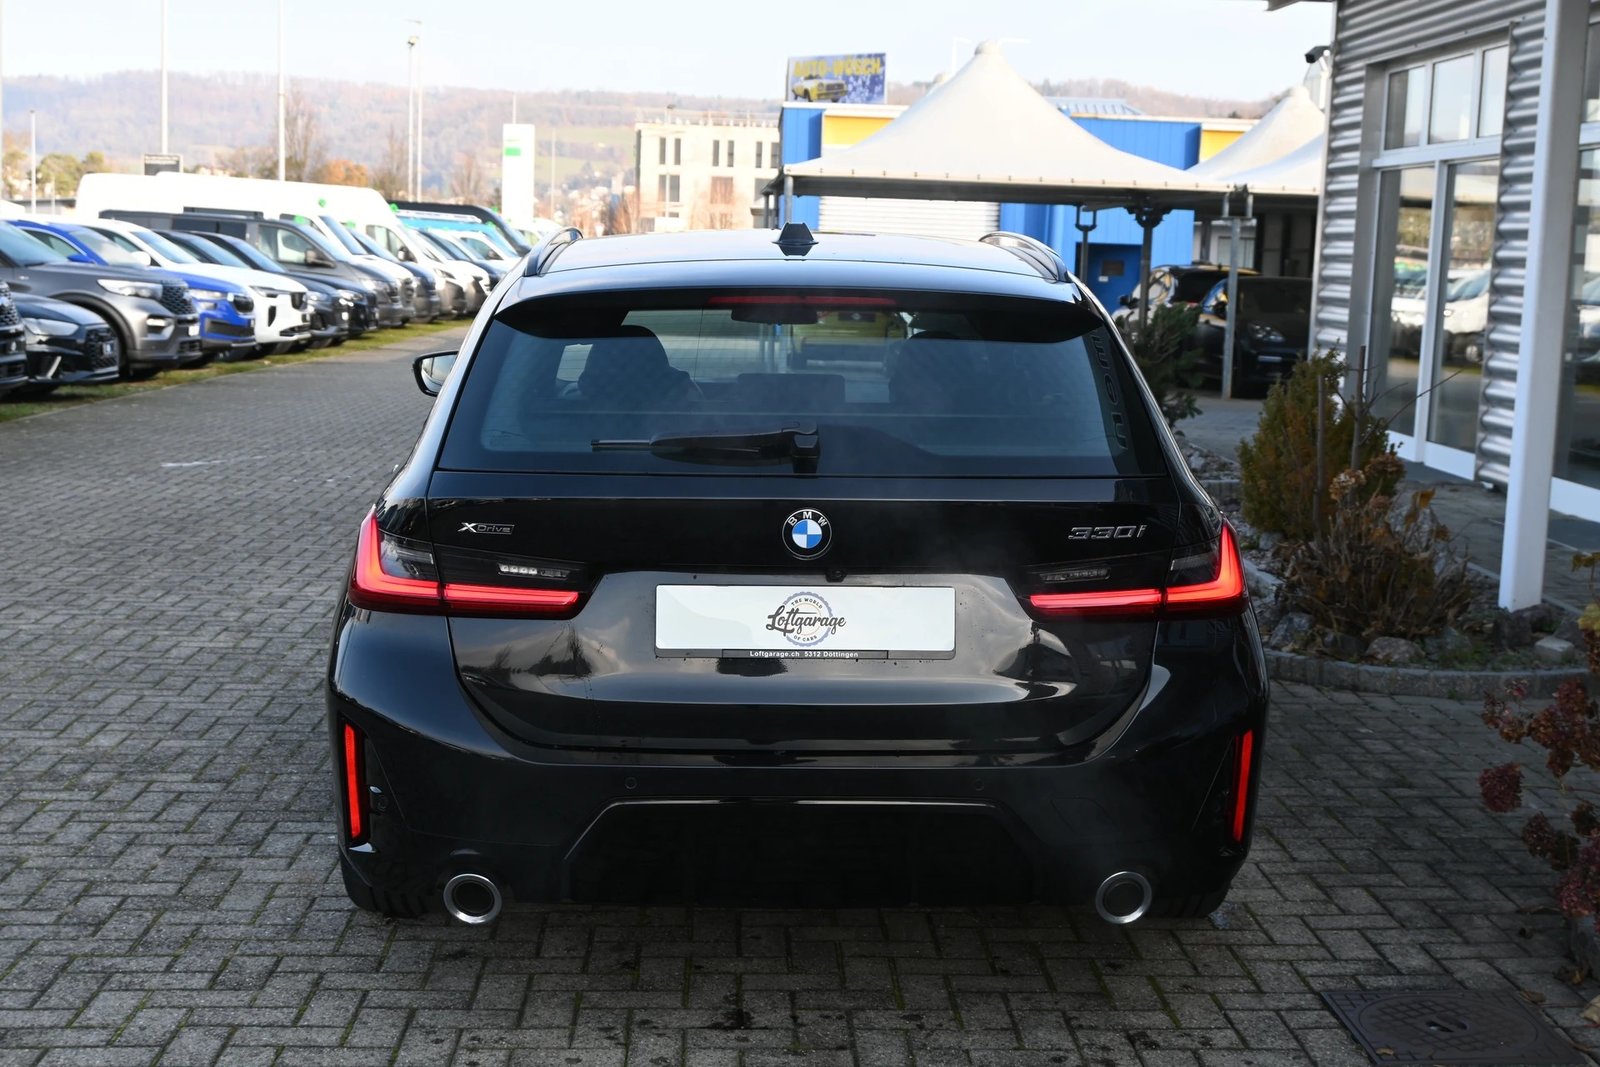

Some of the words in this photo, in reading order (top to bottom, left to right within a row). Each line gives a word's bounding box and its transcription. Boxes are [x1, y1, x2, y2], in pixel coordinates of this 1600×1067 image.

[787, 511, 828, 527] BMW
[1067, 525, 1147, 540] 330i
[804, 597, 823, 609] WORLD
[766, 605, 846, 637] Loftgarage
[749, 650, 800, 658] Loftgarage.ch
[804, 650, 821, 658] 5312
